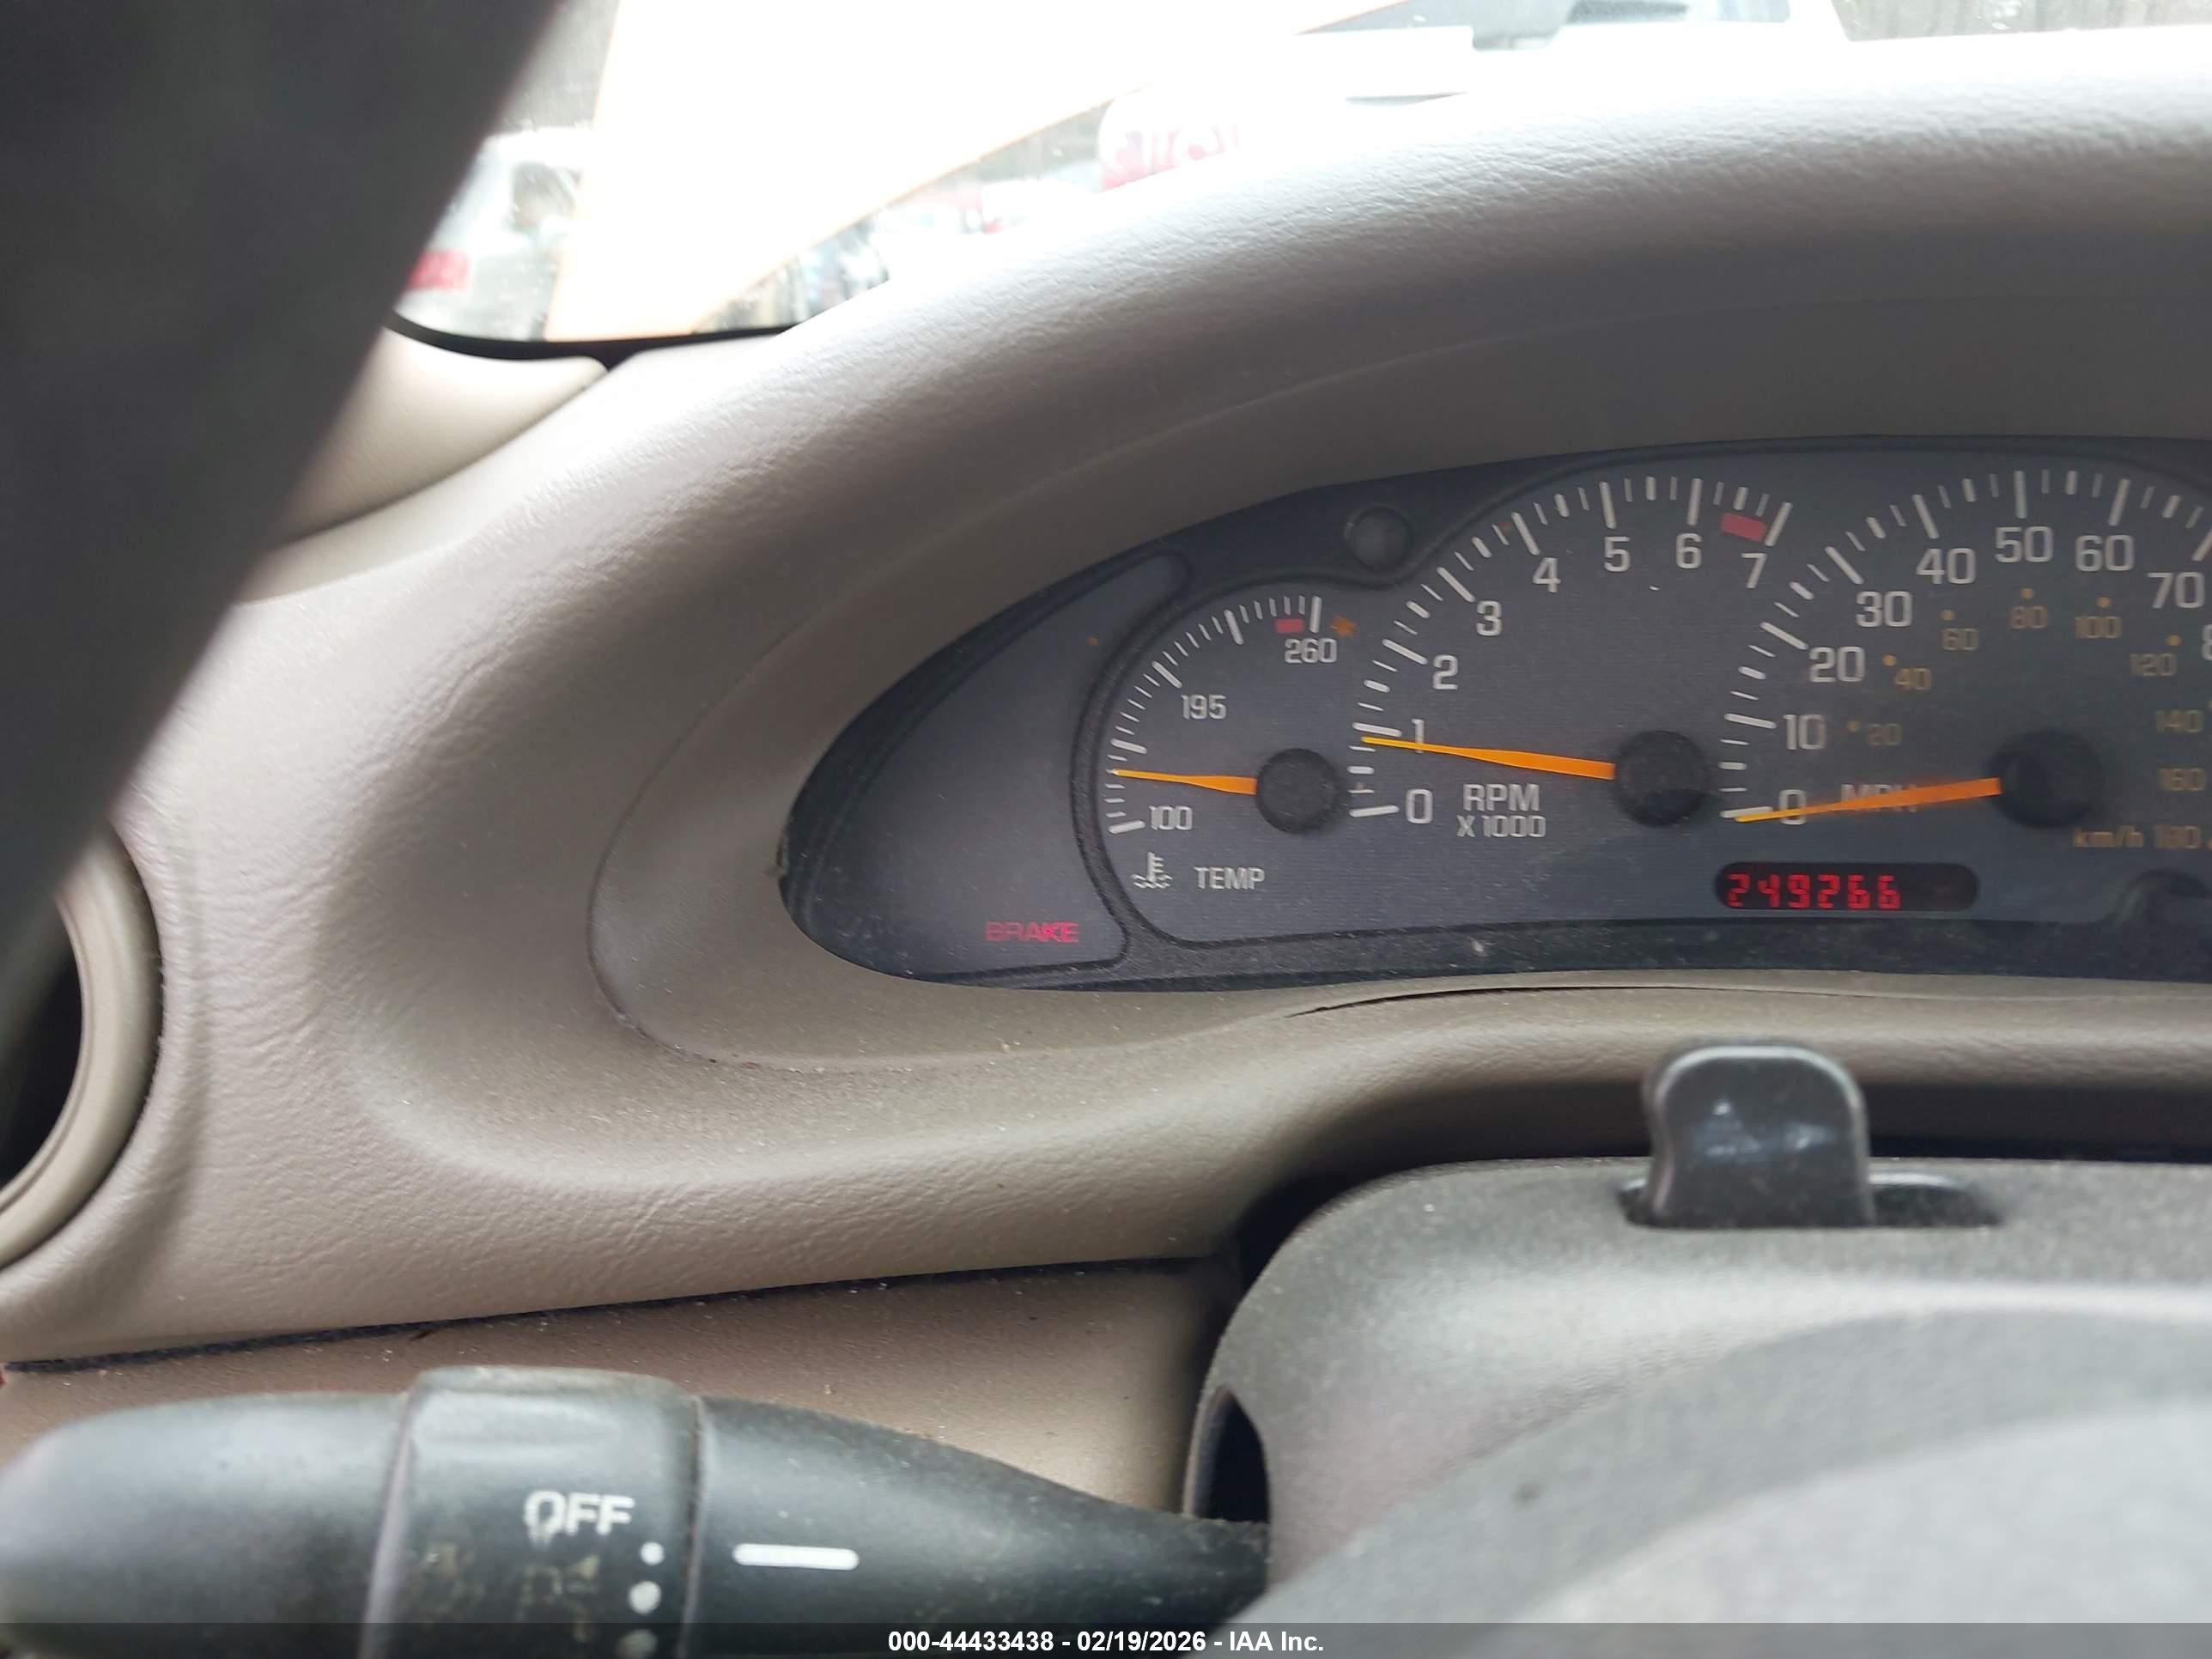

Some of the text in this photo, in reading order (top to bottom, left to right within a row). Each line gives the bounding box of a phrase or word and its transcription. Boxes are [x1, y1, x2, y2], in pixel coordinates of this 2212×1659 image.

[1603, 536, 1631, 572] 5
[1675, 532, 1703, 568] 6
[1996, 526, 2053, 563] 50
[2075, 535, 2134, 571] 60
[1533, 557, 1561, 592] 4
[1741, 552, 1767, 588] 7
[1916, 548, 1975, 585] 40
[2148, 572, 2205, 609] 70
[1476, 600, 1502, 635] 3
[1856, 591, 1913, 628] 30
[2010, 605, 2047, 629] 80
[1942, 627, 1978, 651] 60
[2075, 617, 2122, 639] 100
[1285, 638, 1337, 664] 260
[1810, 646, 1866, 683] 20
[1433, 654, 1458, 690] 2
[1894, 667, 1932, 690] 40
[1182, 695, 1226, 720] 195
[1411, 719, 1425, 753] 1
[1784, 714, 1826, 750] 10
[1406, 788, 1433, 824] 0
[1463, 784, 1540, 811] RPM
[1779, 789, 1807, 825] 0
[1149, 806, 1193, 831] 100
[1481, 817, 1546, 837] 1000
[1195, 867, 1265, 890] TEMP
[1726, 873, 1901, 908] 249266
[985, 921, 1079, 944] BRAKE
[525, 1490, 635, 1540] OFF
